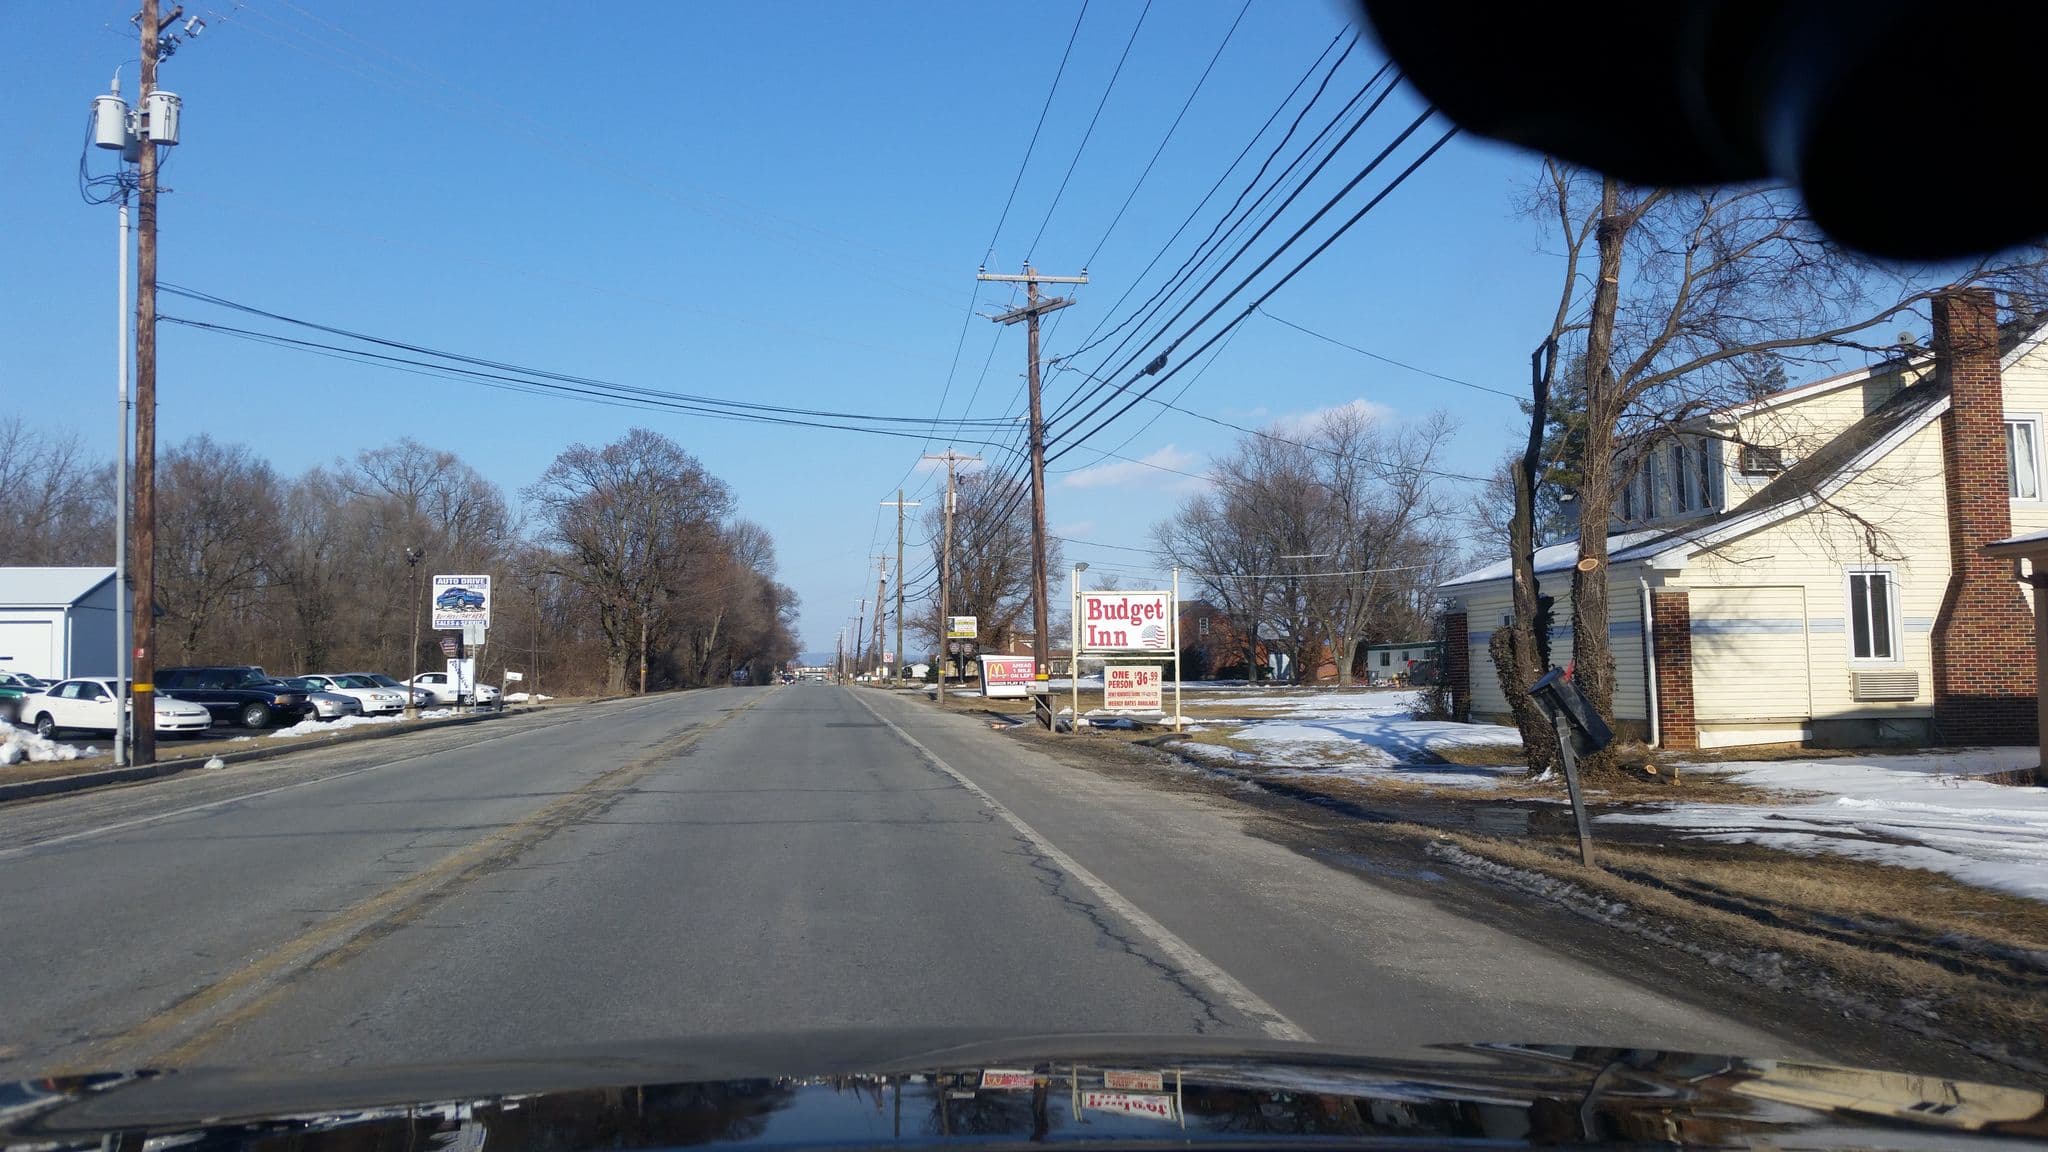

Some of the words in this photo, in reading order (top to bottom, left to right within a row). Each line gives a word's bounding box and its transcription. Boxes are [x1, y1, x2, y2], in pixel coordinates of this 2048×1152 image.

[1087, 598, 1164, 626] Budget
[1087, 625, 1128, 646] Inn
[1112, 671, 1129, 679] ONE
[1108, 680, 1133, 688] PERSON
